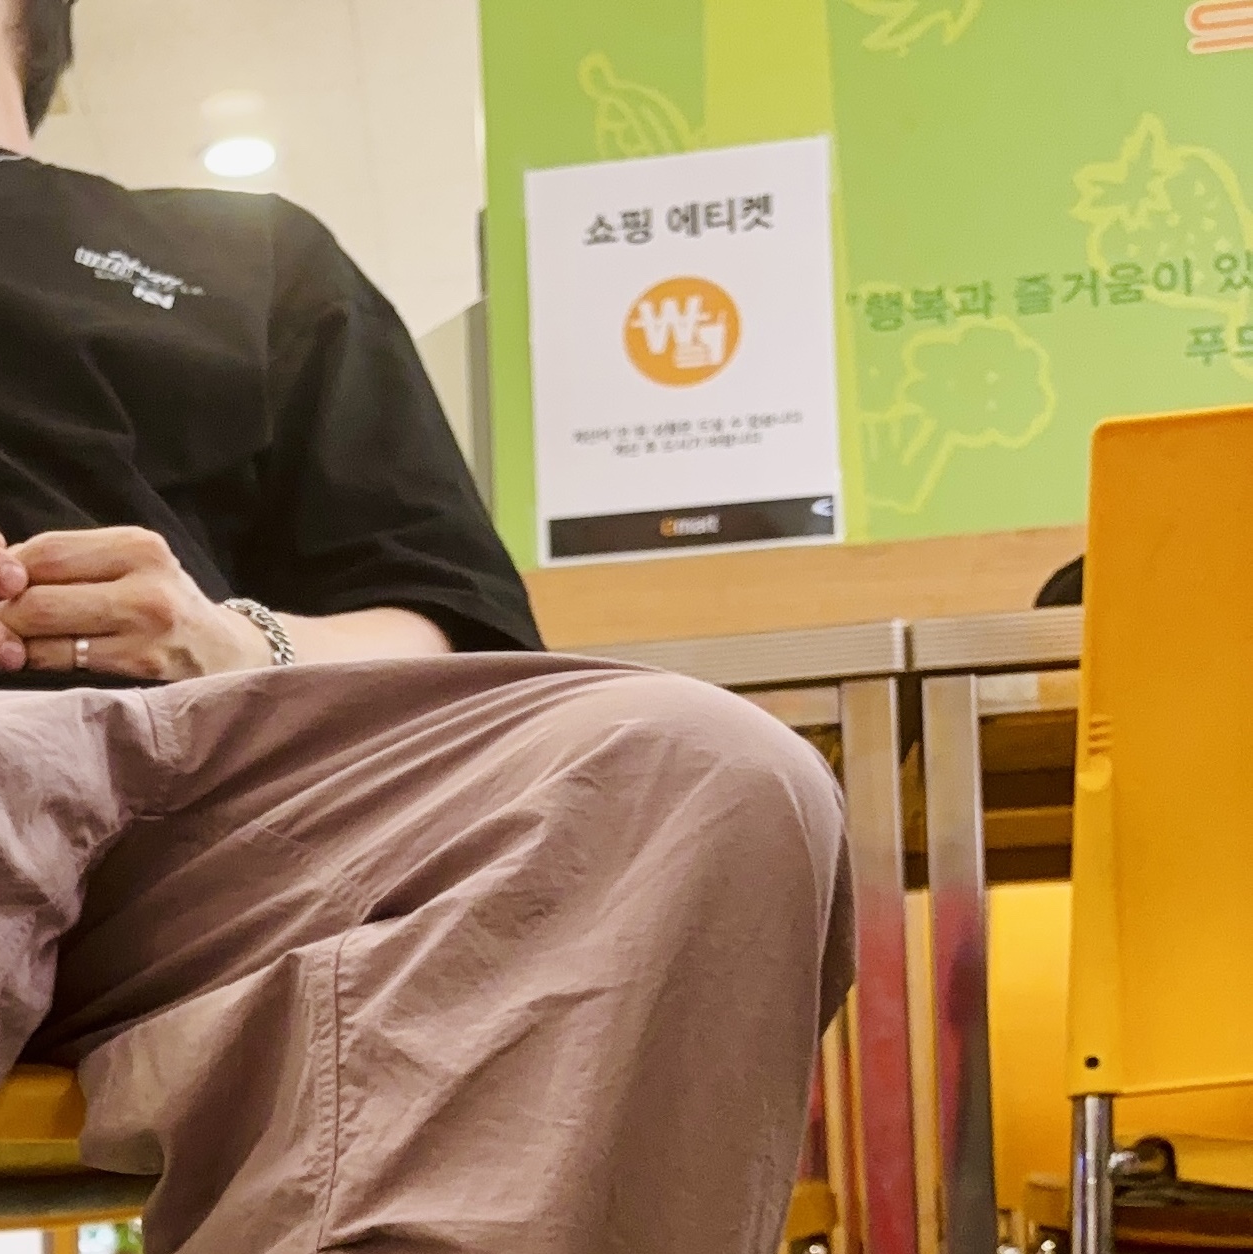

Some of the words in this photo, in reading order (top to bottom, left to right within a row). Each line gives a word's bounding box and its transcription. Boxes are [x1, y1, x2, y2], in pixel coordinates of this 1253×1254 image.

[583, 207, 654, 246] 쇼핑
[665, 193, 774, 238] 에티켓
[1015, 257, 1193, 316] 즐거움이
